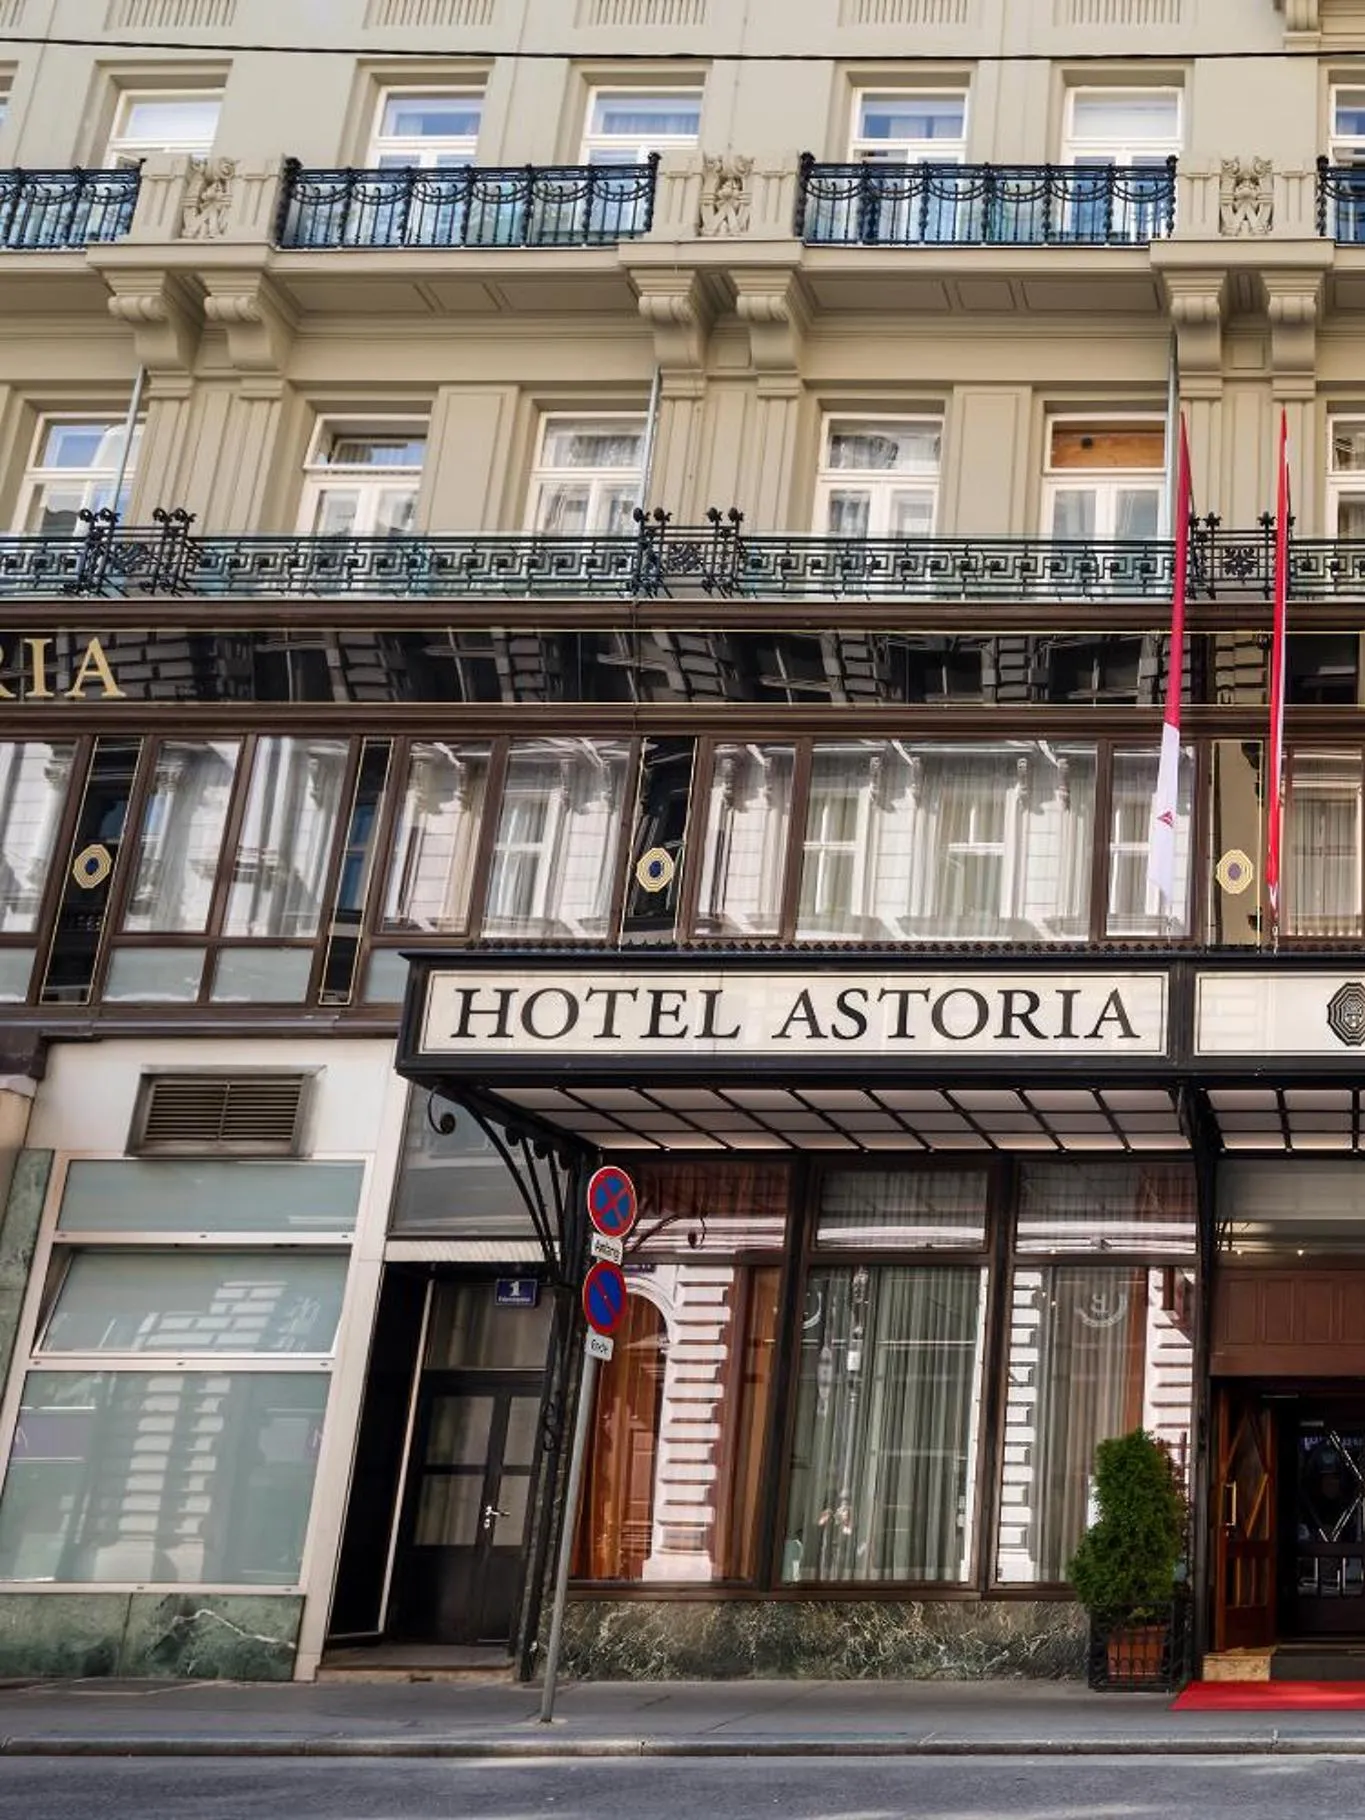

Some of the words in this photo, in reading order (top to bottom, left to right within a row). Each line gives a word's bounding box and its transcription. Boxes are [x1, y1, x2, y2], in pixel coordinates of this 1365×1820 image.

[450, 986, 741, 1040] HOTEL
[770, 986, 1141, 1040] ASTORIA
[510, 1280, 520, 1297] 1
